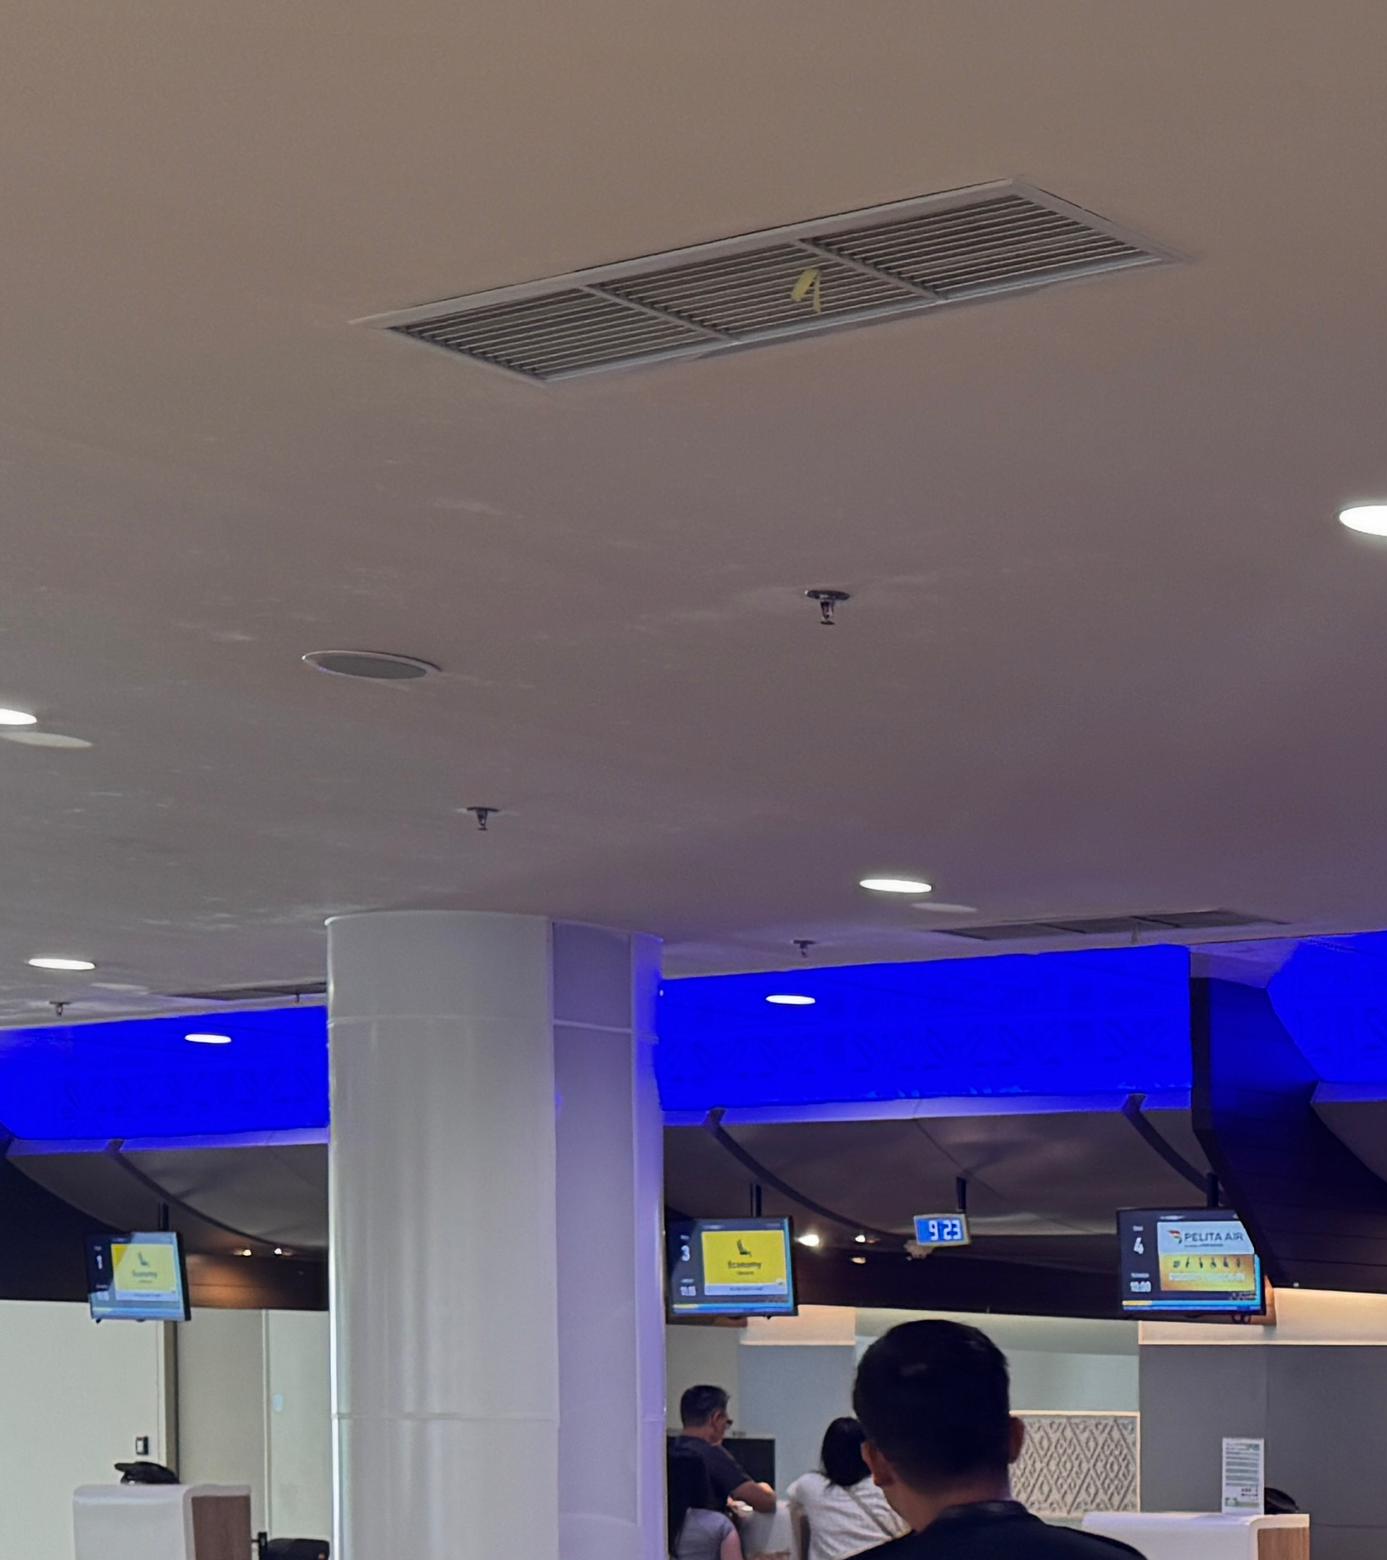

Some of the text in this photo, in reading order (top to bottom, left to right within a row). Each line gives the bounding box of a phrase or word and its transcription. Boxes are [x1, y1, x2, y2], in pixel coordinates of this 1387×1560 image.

[1184, 1231, 1244, 1242] PELITA AIR
[681, 1245, 691, 1262] 3
[1133, 1237, 1144, 1254] 4
